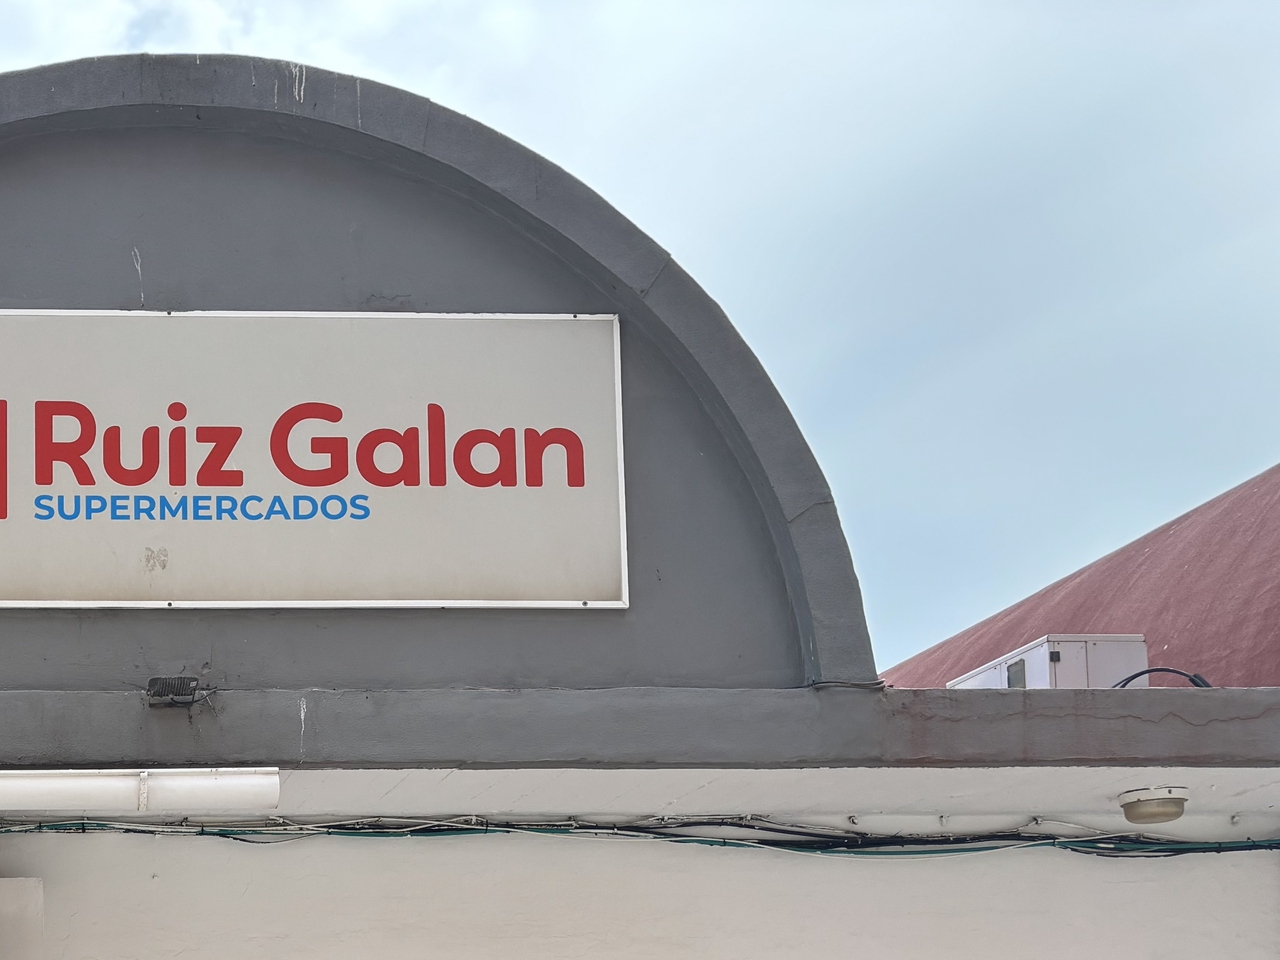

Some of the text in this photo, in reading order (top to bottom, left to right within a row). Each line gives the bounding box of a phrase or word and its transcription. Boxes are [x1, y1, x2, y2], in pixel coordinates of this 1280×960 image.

[35, 400, 586, 487] Ruiz Galan
[33, 494, 371, 521] SUPERMERCADOS
